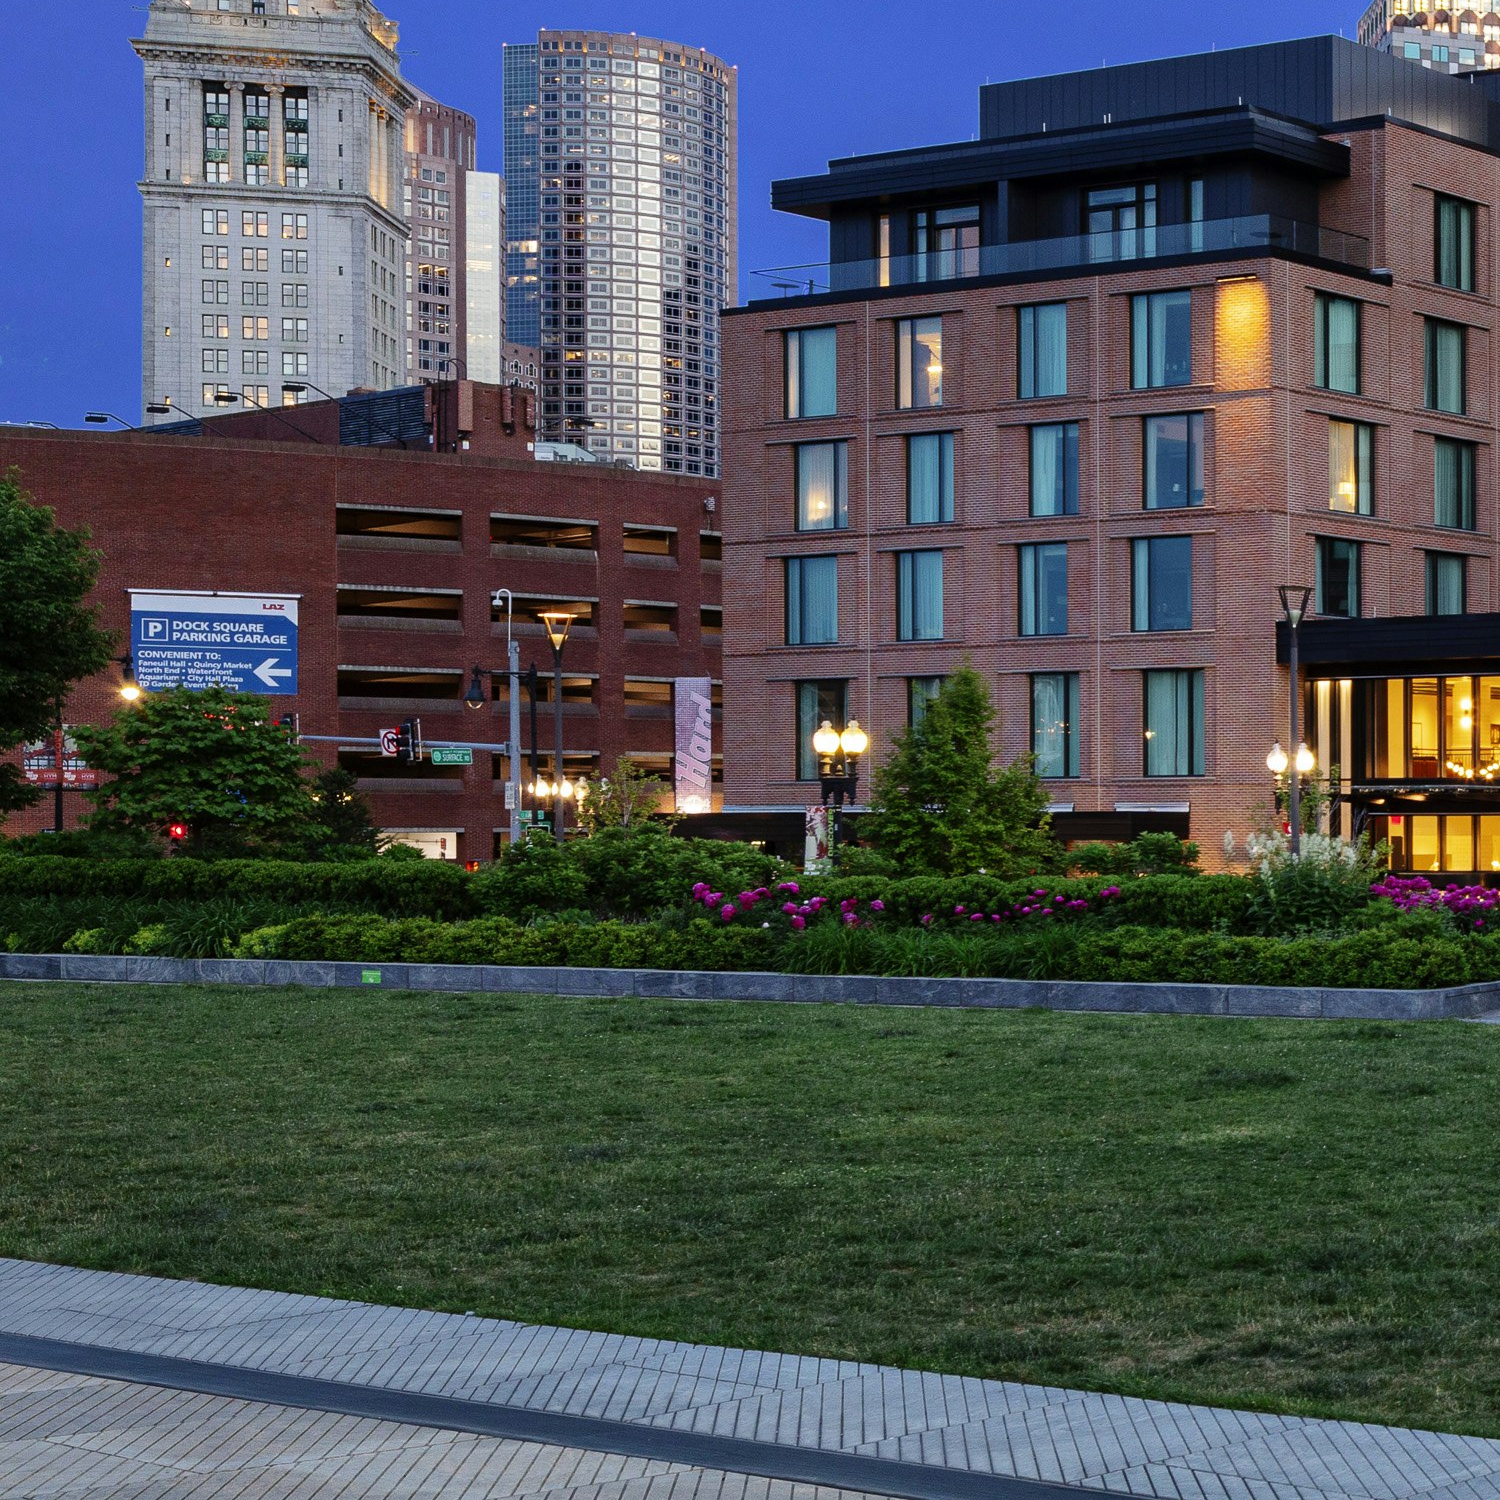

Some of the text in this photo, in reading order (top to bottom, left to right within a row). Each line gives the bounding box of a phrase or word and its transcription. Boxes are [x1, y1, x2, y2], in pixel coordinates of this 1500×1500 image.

[262, 603, 285, 611] LAZ
[149, 622, 162, 637] P
[172, 621, 264, 633] DOCK SQUARE
[172, 632, 288, 645] PARKING GARAGE
[138, 650, 221, 660] CONVENIENT TO:
[193, 661, 222, 669] Quincy
